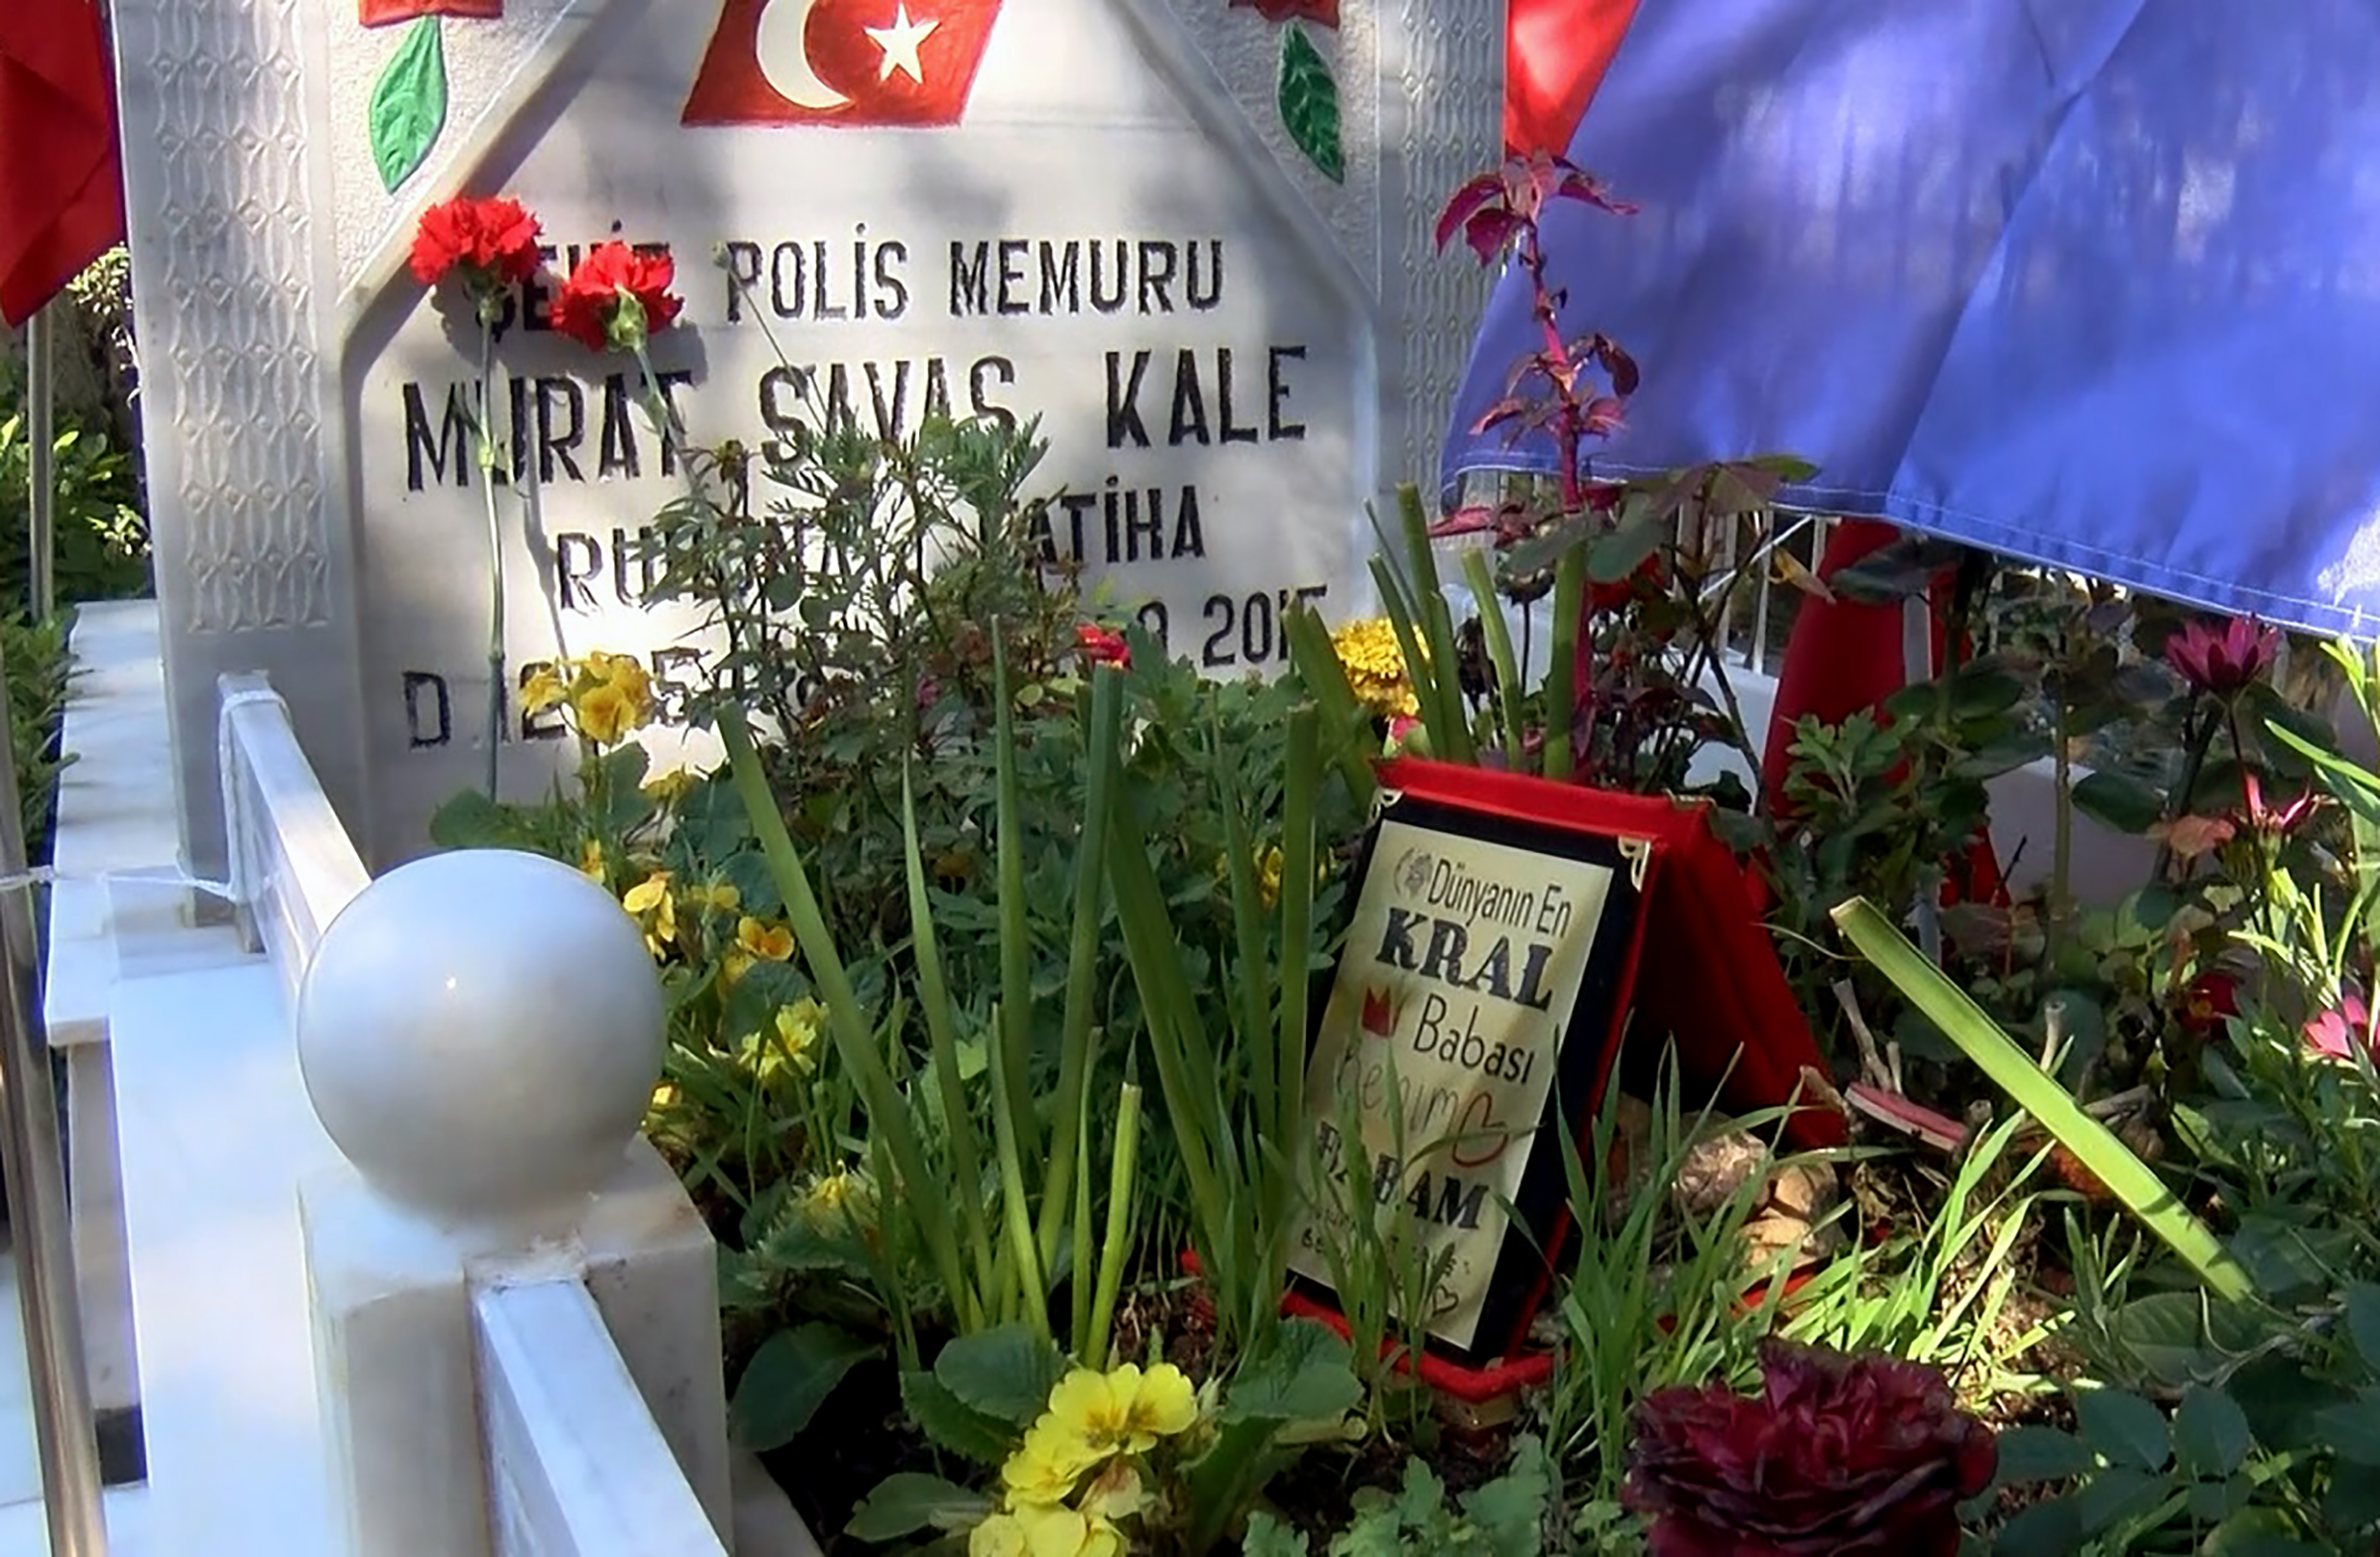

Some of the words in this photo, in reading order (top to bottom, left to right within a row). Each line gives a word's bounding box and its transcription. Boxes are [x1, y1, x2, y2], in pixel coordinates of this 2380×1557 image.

[727, 223, 909, 323] POLİS
[949, 238, 1223, 316] MEMURU
[403, 370, 692, 491] MURAT
[1105, 345, 1307, 448] KALE
[1012, 475, 1205, 564] ATİHA
[1203, 584, 1328, 667] 201
[1428, 858, 1534, 927] Dünyanın
[1536, 884, 1572, 938] En
[1375, 906, 1554, 1013] KRAL
[1413, 993, 1536, 1085] Babası
[1317, 1120, 1490, 1230] BBAM
